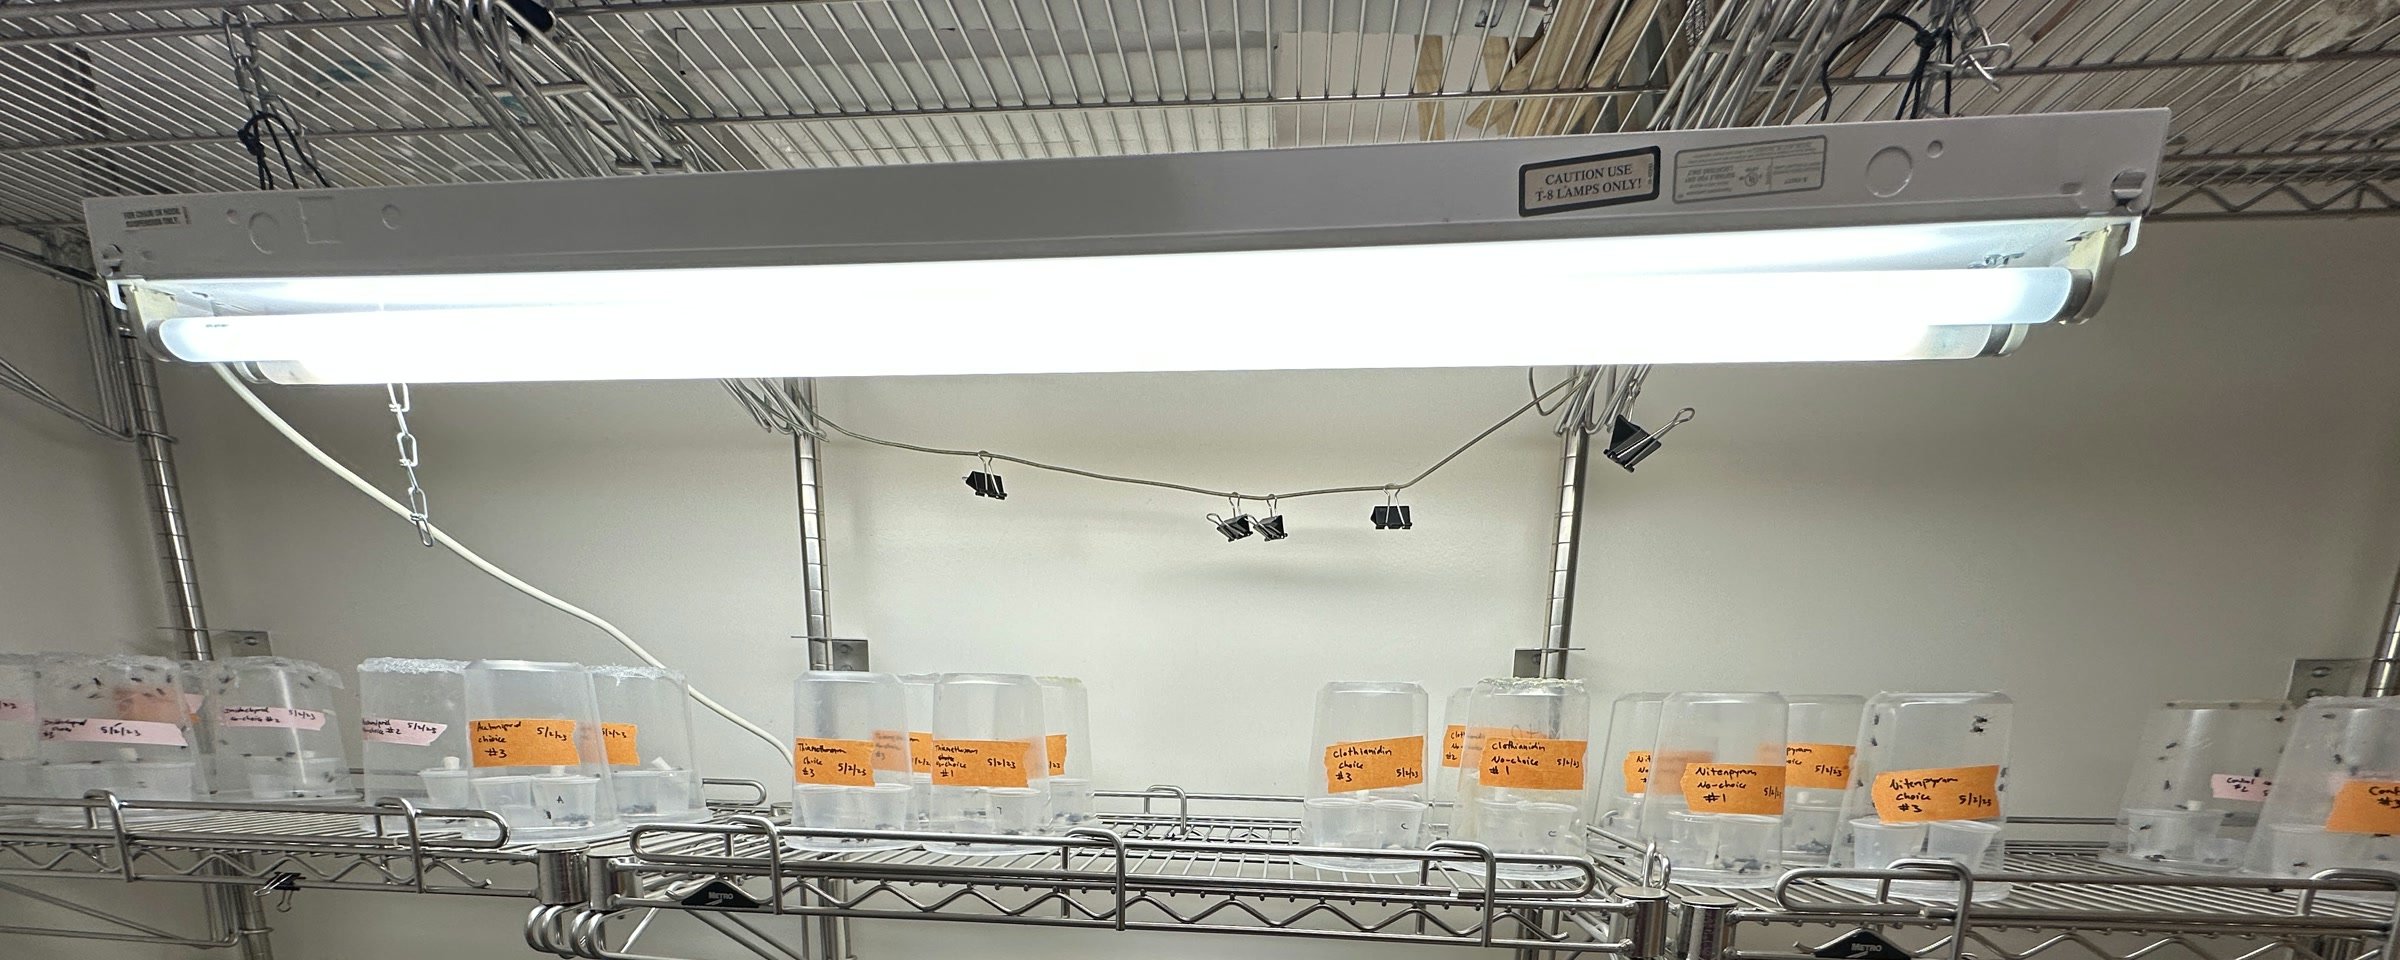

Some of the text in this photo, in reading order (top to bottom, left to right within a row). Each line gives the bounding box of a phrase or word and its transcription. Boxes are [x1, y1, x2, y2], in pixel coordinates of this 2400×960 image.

[1545, 168, 1604, 186] CAUTION
[1608, 164, 1633, 177] USE
[1536, 178, 1642, 202] T-8 LAMPS ONLY!
[536, 726, 567, 741] 5/2/23
[484, 748, 507, 758] #3
[838, 762, 867, 776] 5/2/23
[987, 758, 1016, 769] 5/2/23
[802, 767, 815, 777] #3
[940, 769, 954, 777] #1
[1335, 771, 1352, 782] #3
[1703, 792, 1726, 803] #1
[1898, 803, 1922, 813] #3
[708, 891, 733, 900] METRO
[1851, 943, 1882, 952] METRO
